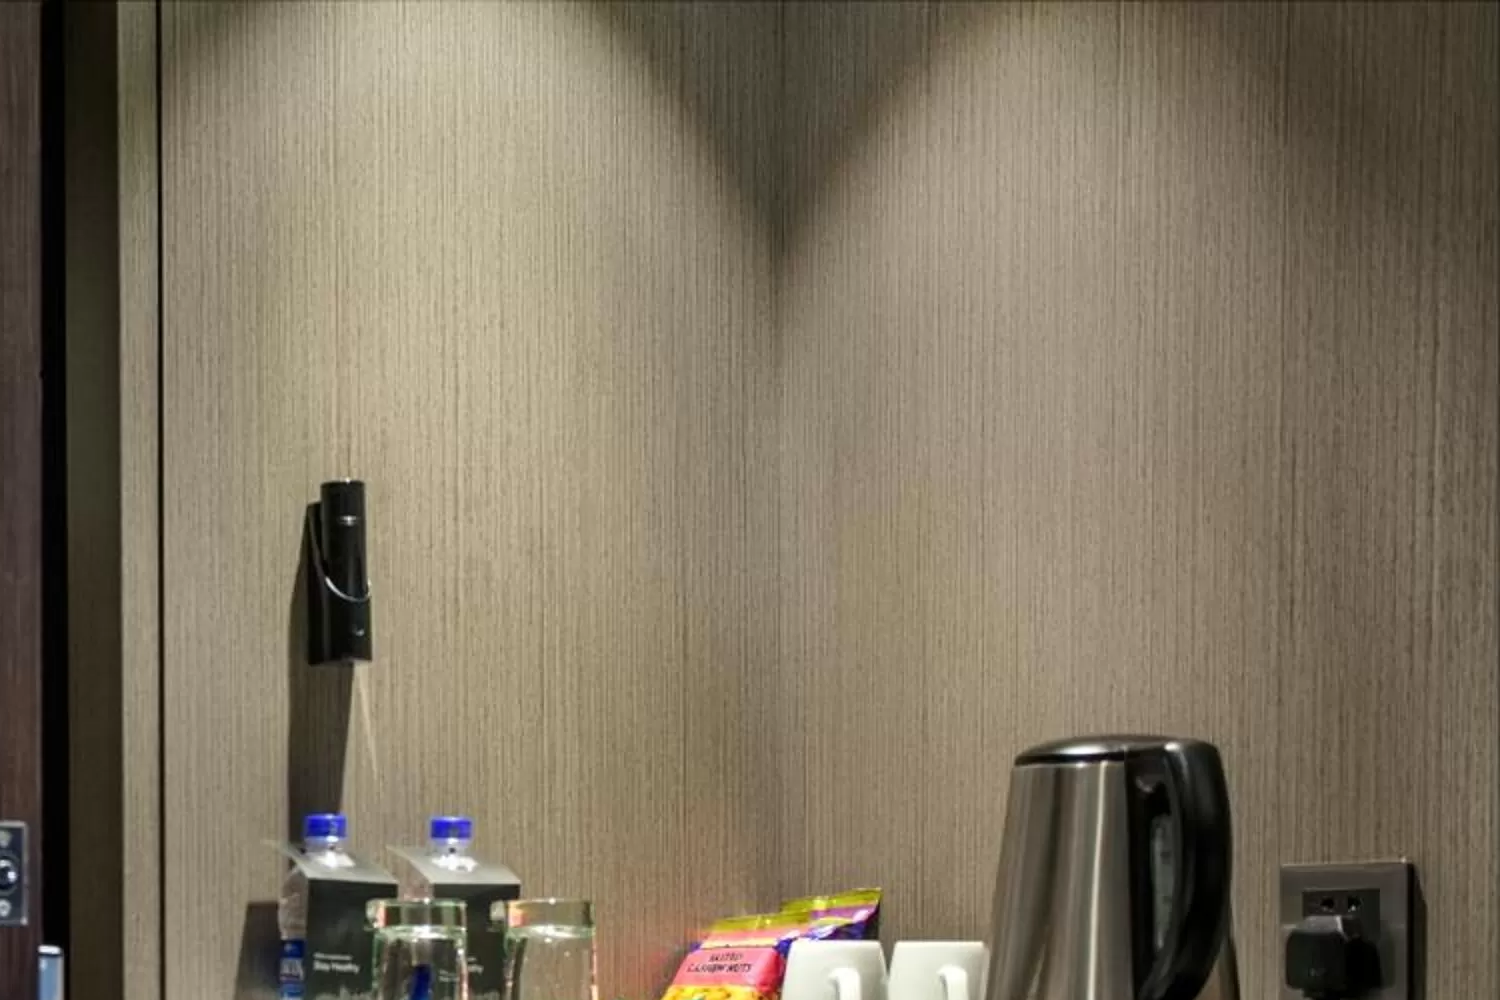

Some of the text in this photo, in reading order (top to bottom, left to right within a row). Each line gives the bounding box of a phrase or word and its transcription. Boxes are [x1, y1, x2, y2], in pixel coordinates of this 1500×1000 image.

[709, 952, 744, 963] SALTED
[686, 963, 753, 974] CASHEW NUTS
